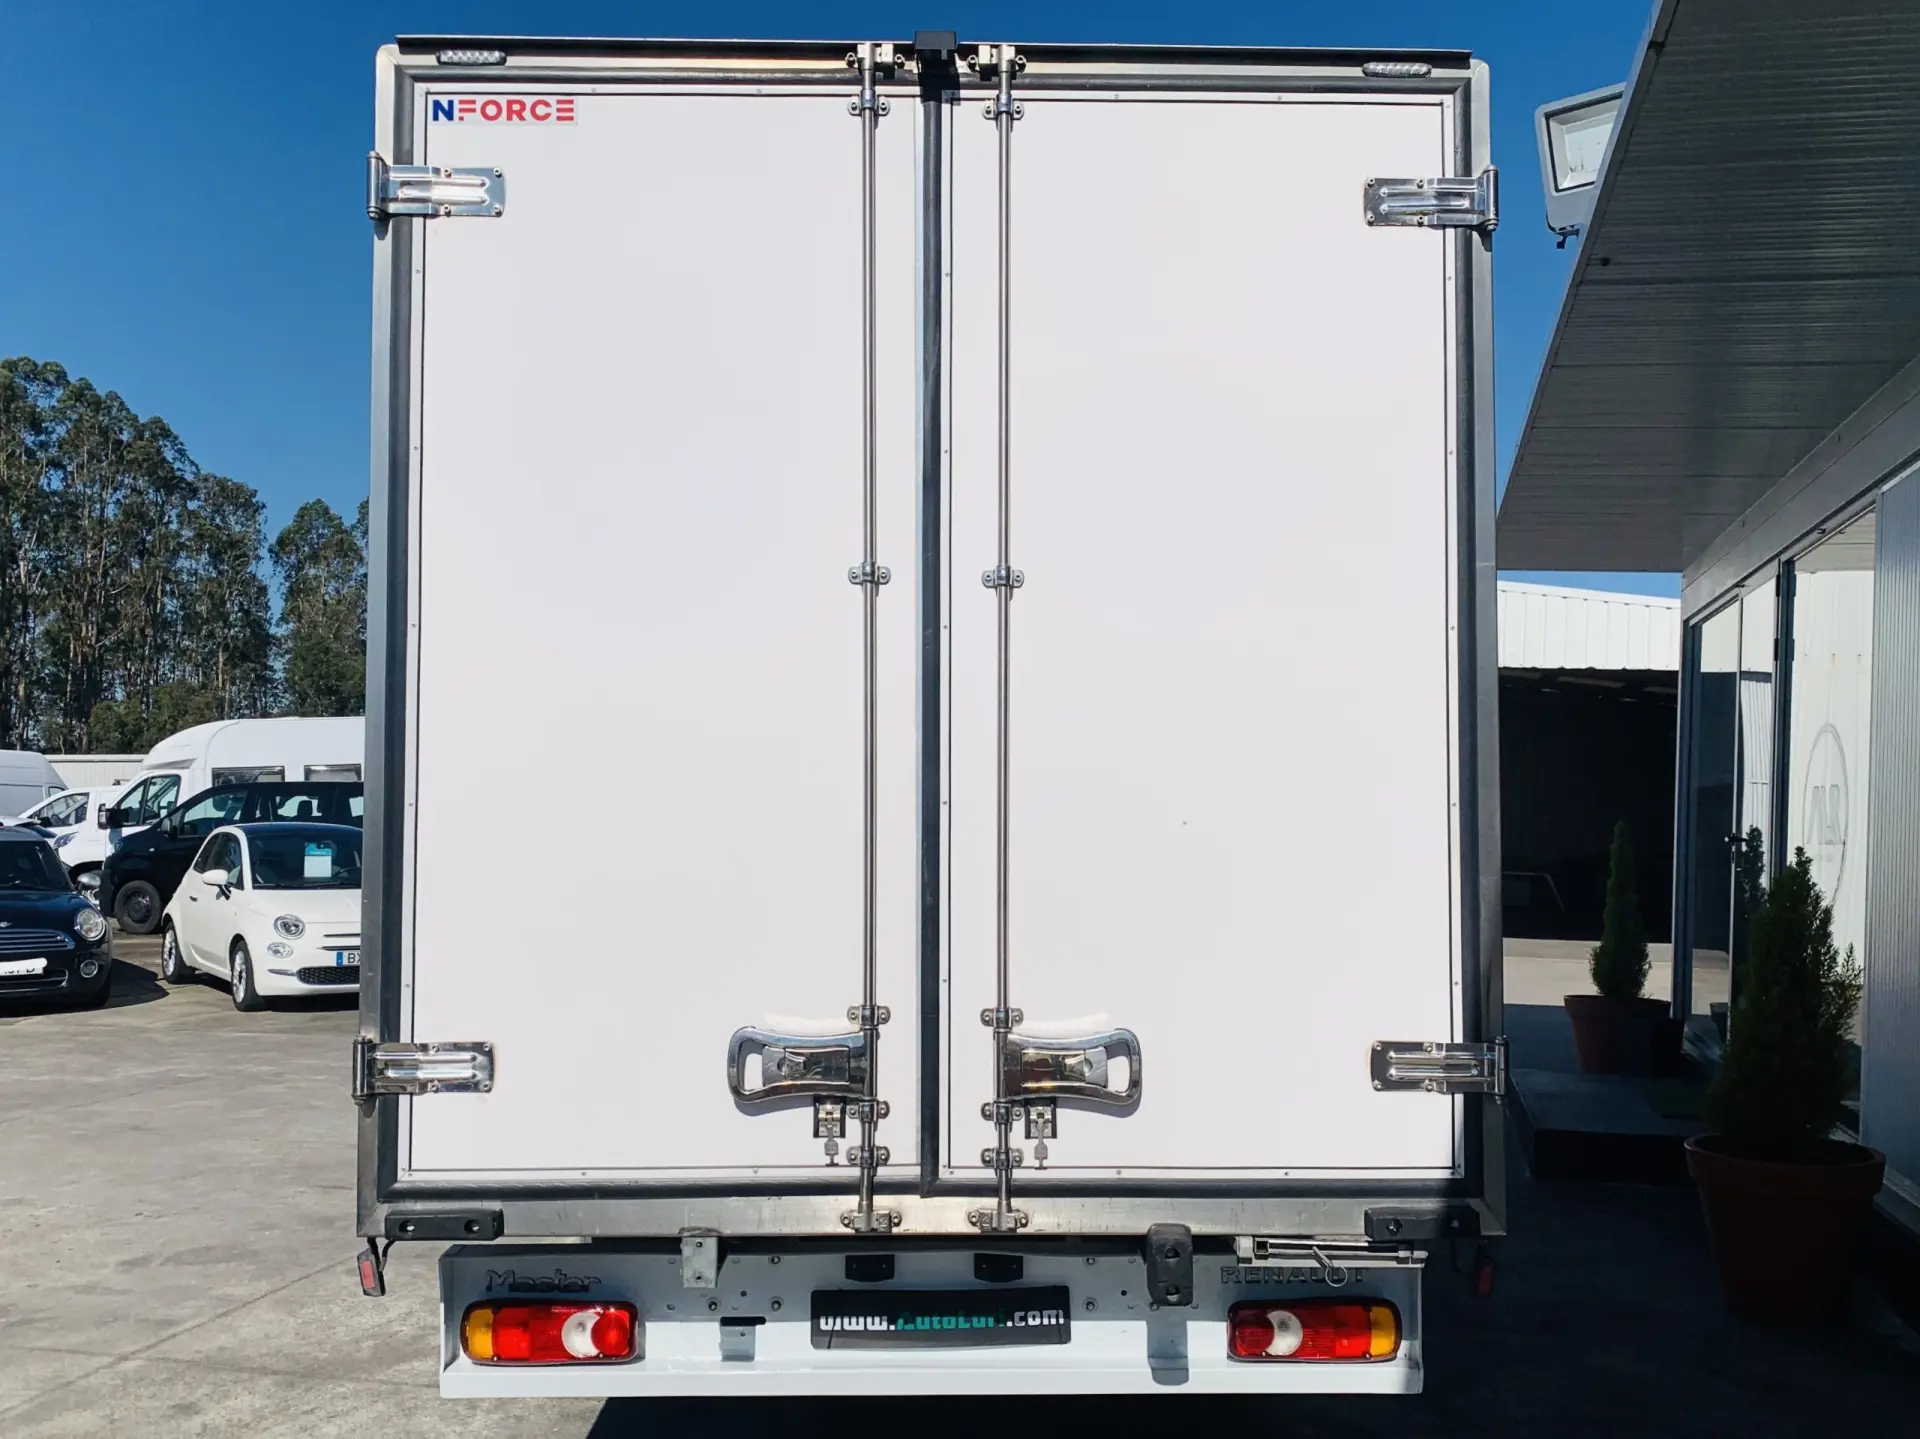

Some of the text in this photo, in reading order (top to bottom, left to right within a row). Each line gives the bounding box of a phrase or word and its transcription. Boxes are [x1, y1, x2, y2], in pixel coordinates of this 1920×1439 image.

[432, 99, 575, 122] NFORCE
[485, 1268, 602, 1293] Master
[1220, 1266, 1370, 1284] RENAULT
